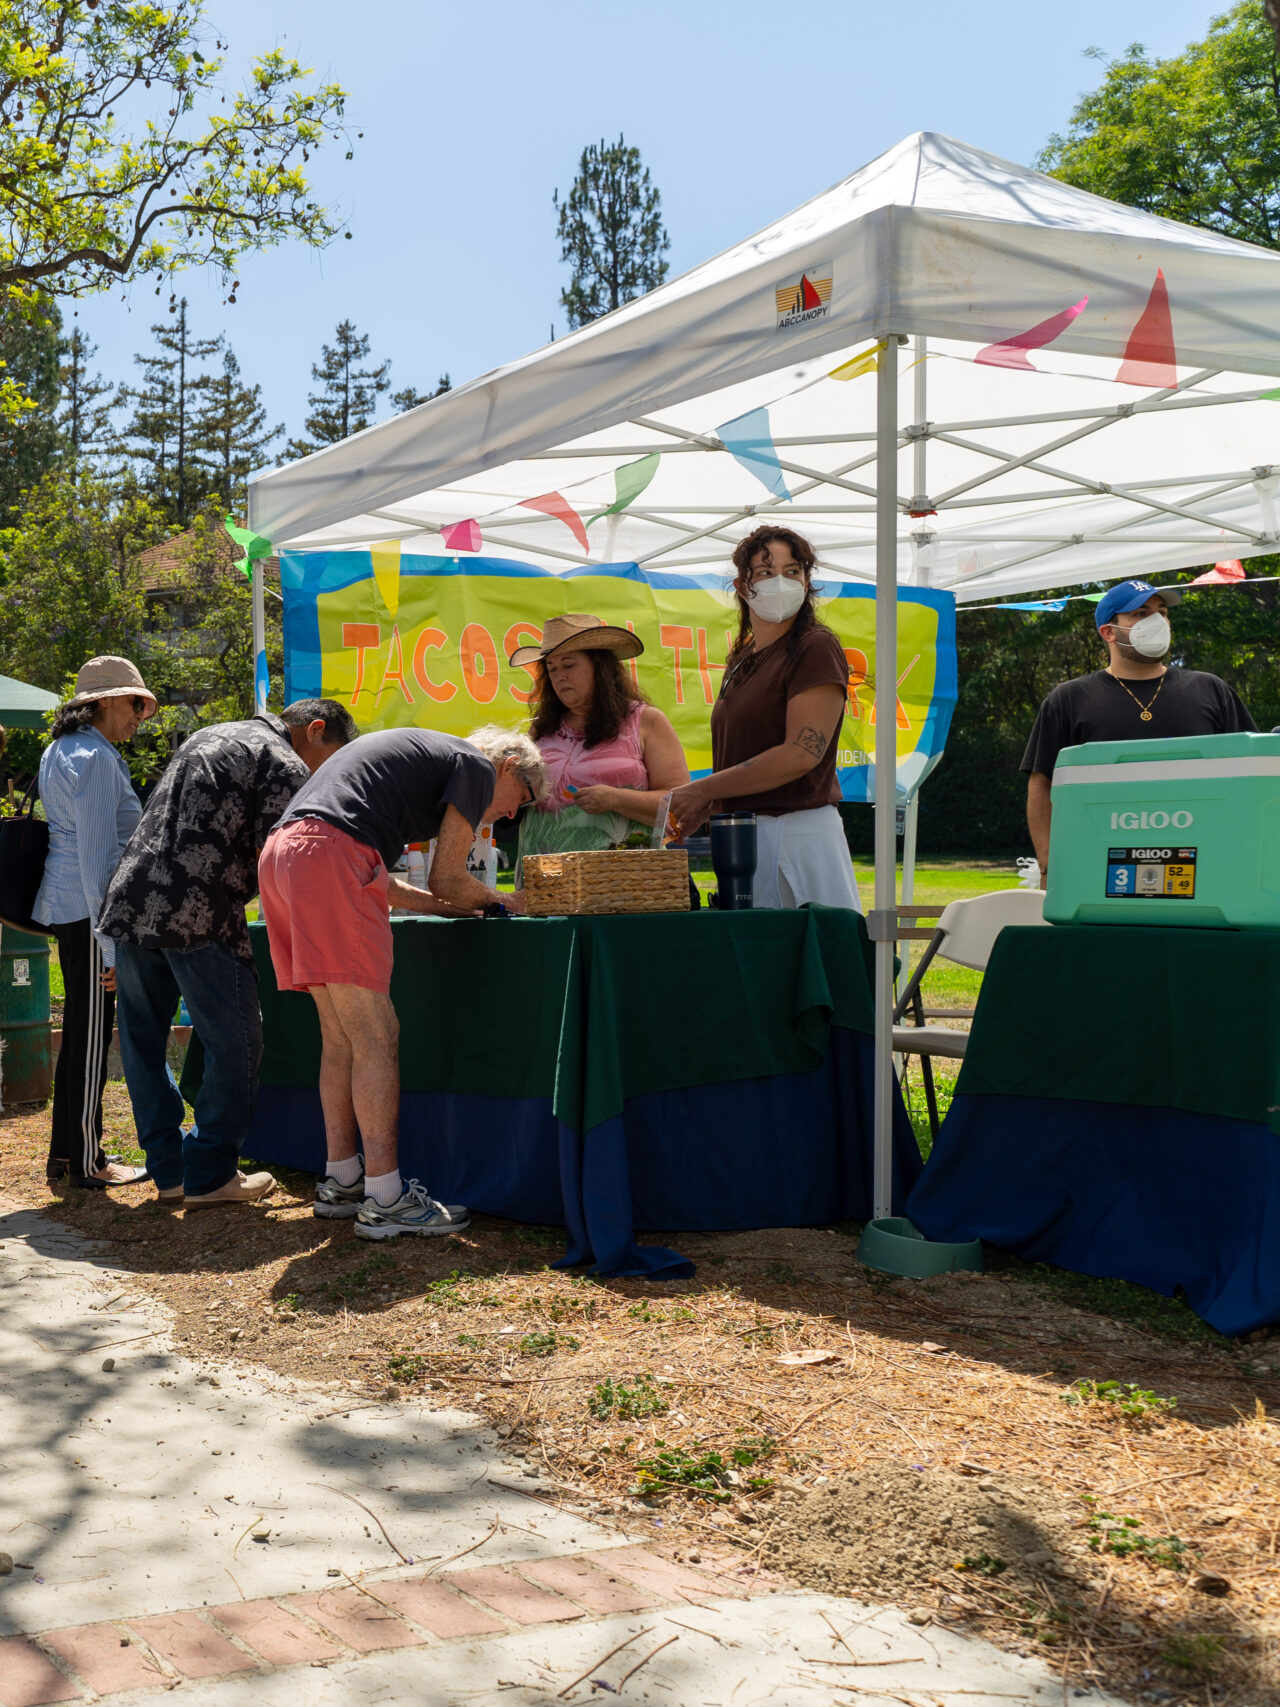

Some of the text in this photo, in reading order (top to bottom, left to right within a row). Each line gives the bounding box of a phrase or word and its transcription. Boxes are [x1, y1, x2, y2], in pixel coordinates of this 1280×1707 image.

[779, 306, 828, 329] ABCCANOPY
[1128, 581, 1151, 592] LA
[341, 622, 543, 708] TACOS
[659, 623, 754, 704] TH
[1110, 811, 1194, 830] IGLOO
[1131, 849, 1172, 859] IGLOO
[1115, 868, 1128, 886] 3
[1168, 867, 1184, 876] 52
